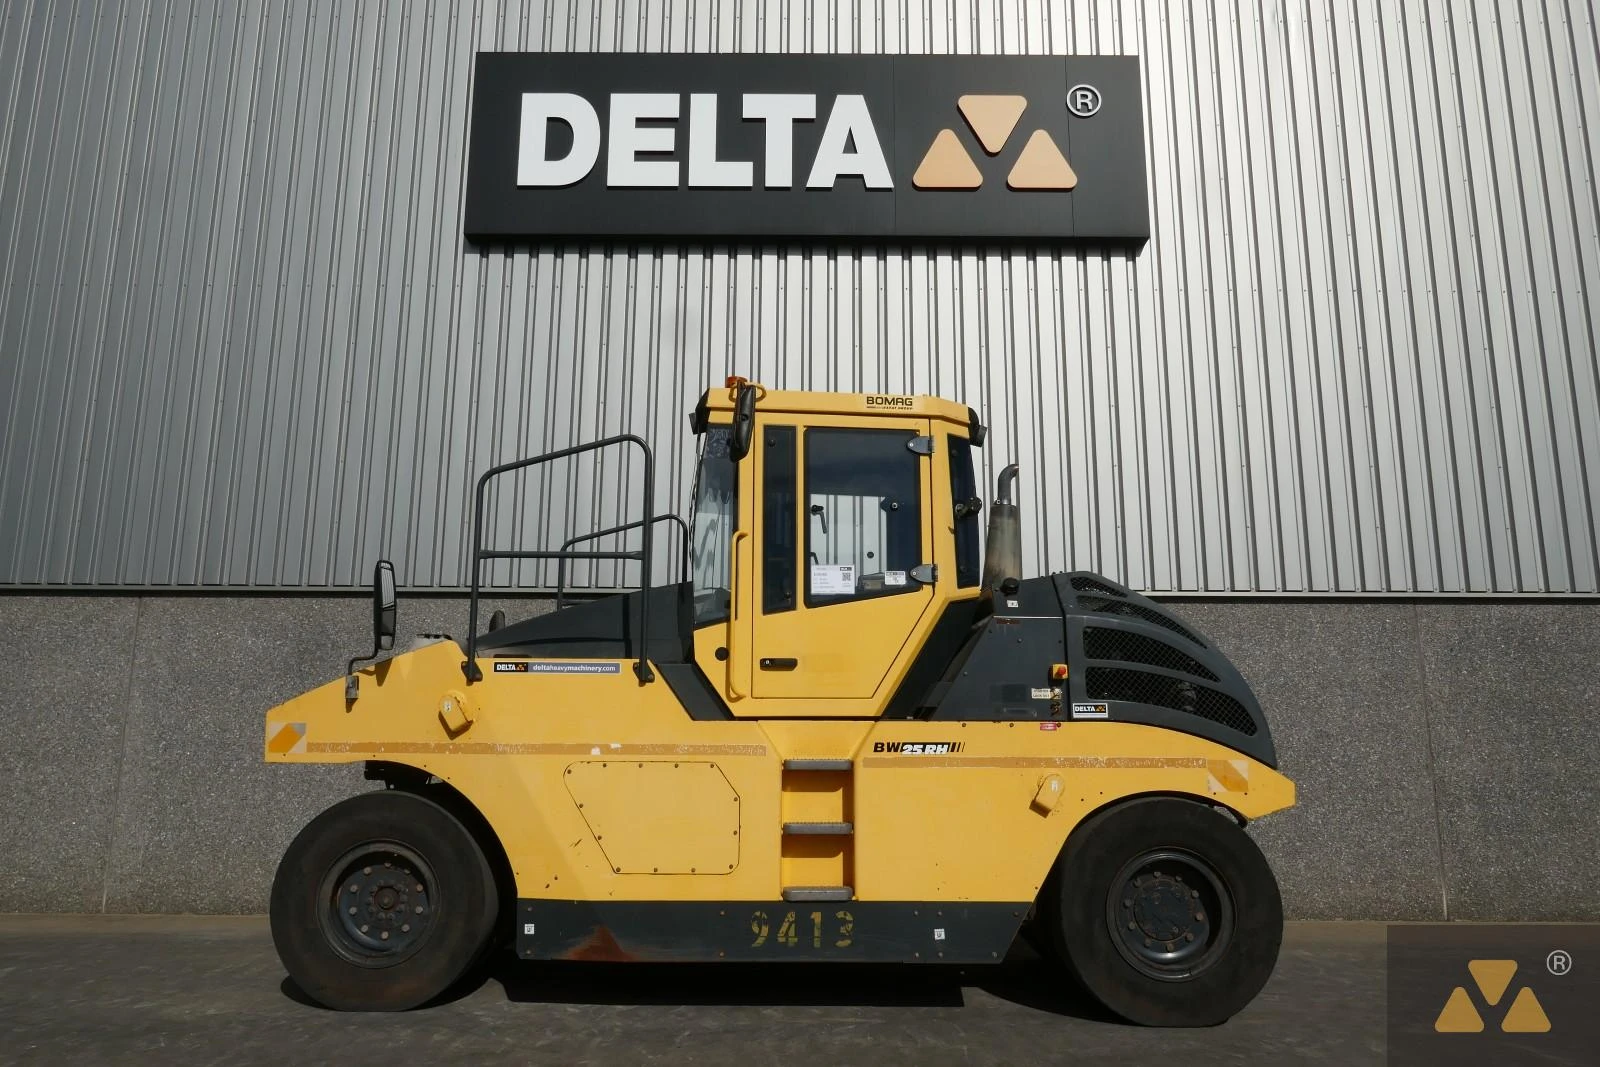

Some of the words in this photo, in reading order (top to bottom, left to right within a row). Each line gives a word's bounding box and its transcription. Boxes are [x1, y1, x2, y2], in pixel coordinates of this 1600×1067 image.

[517, 93, 895, 189] DELTA
[866, 396, 913, 406] BOMAG
[533, 664, 616, 673] deltaheavymachinery.com
[751, 910, 854, 948] 9413
